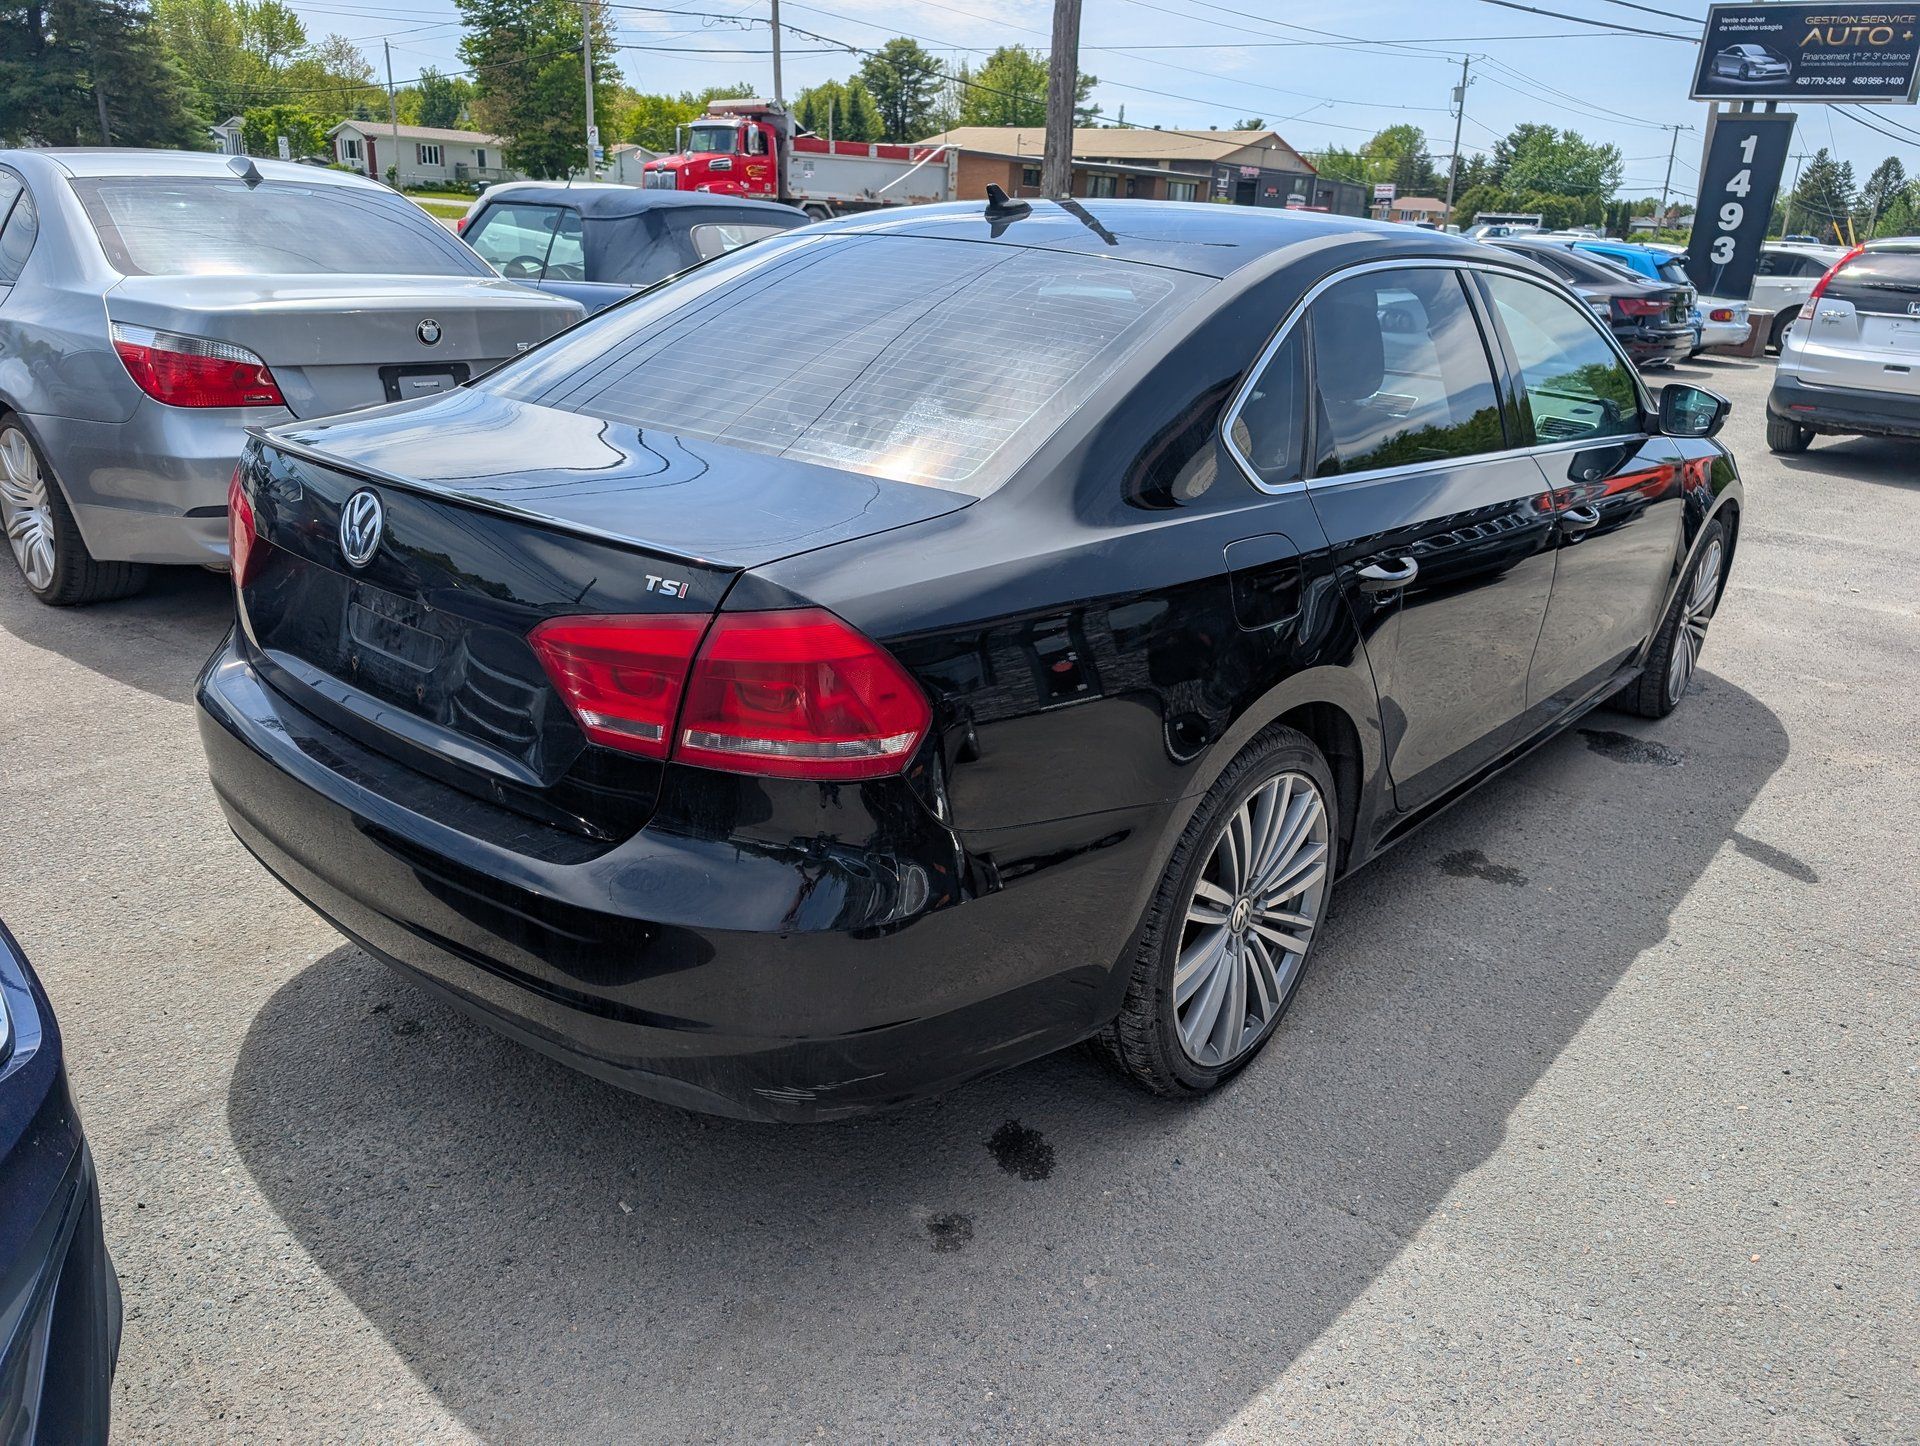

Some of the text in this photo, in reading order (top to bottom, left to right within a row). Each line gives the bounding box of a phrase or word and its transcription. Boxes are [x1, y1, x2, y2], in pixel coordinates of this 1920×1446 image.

[1721, 16, 1739, 24] Vente
[1805, 15, 1916, 25] GESTION SERVICE
[1799, 26, 1894, 47] AUTO
[1802, 52, 1850, 60] Financement
[1882, 52, 1911, 60] chance
[1796, 77, 1905, 85] 450 770-2424 450 956-1400
